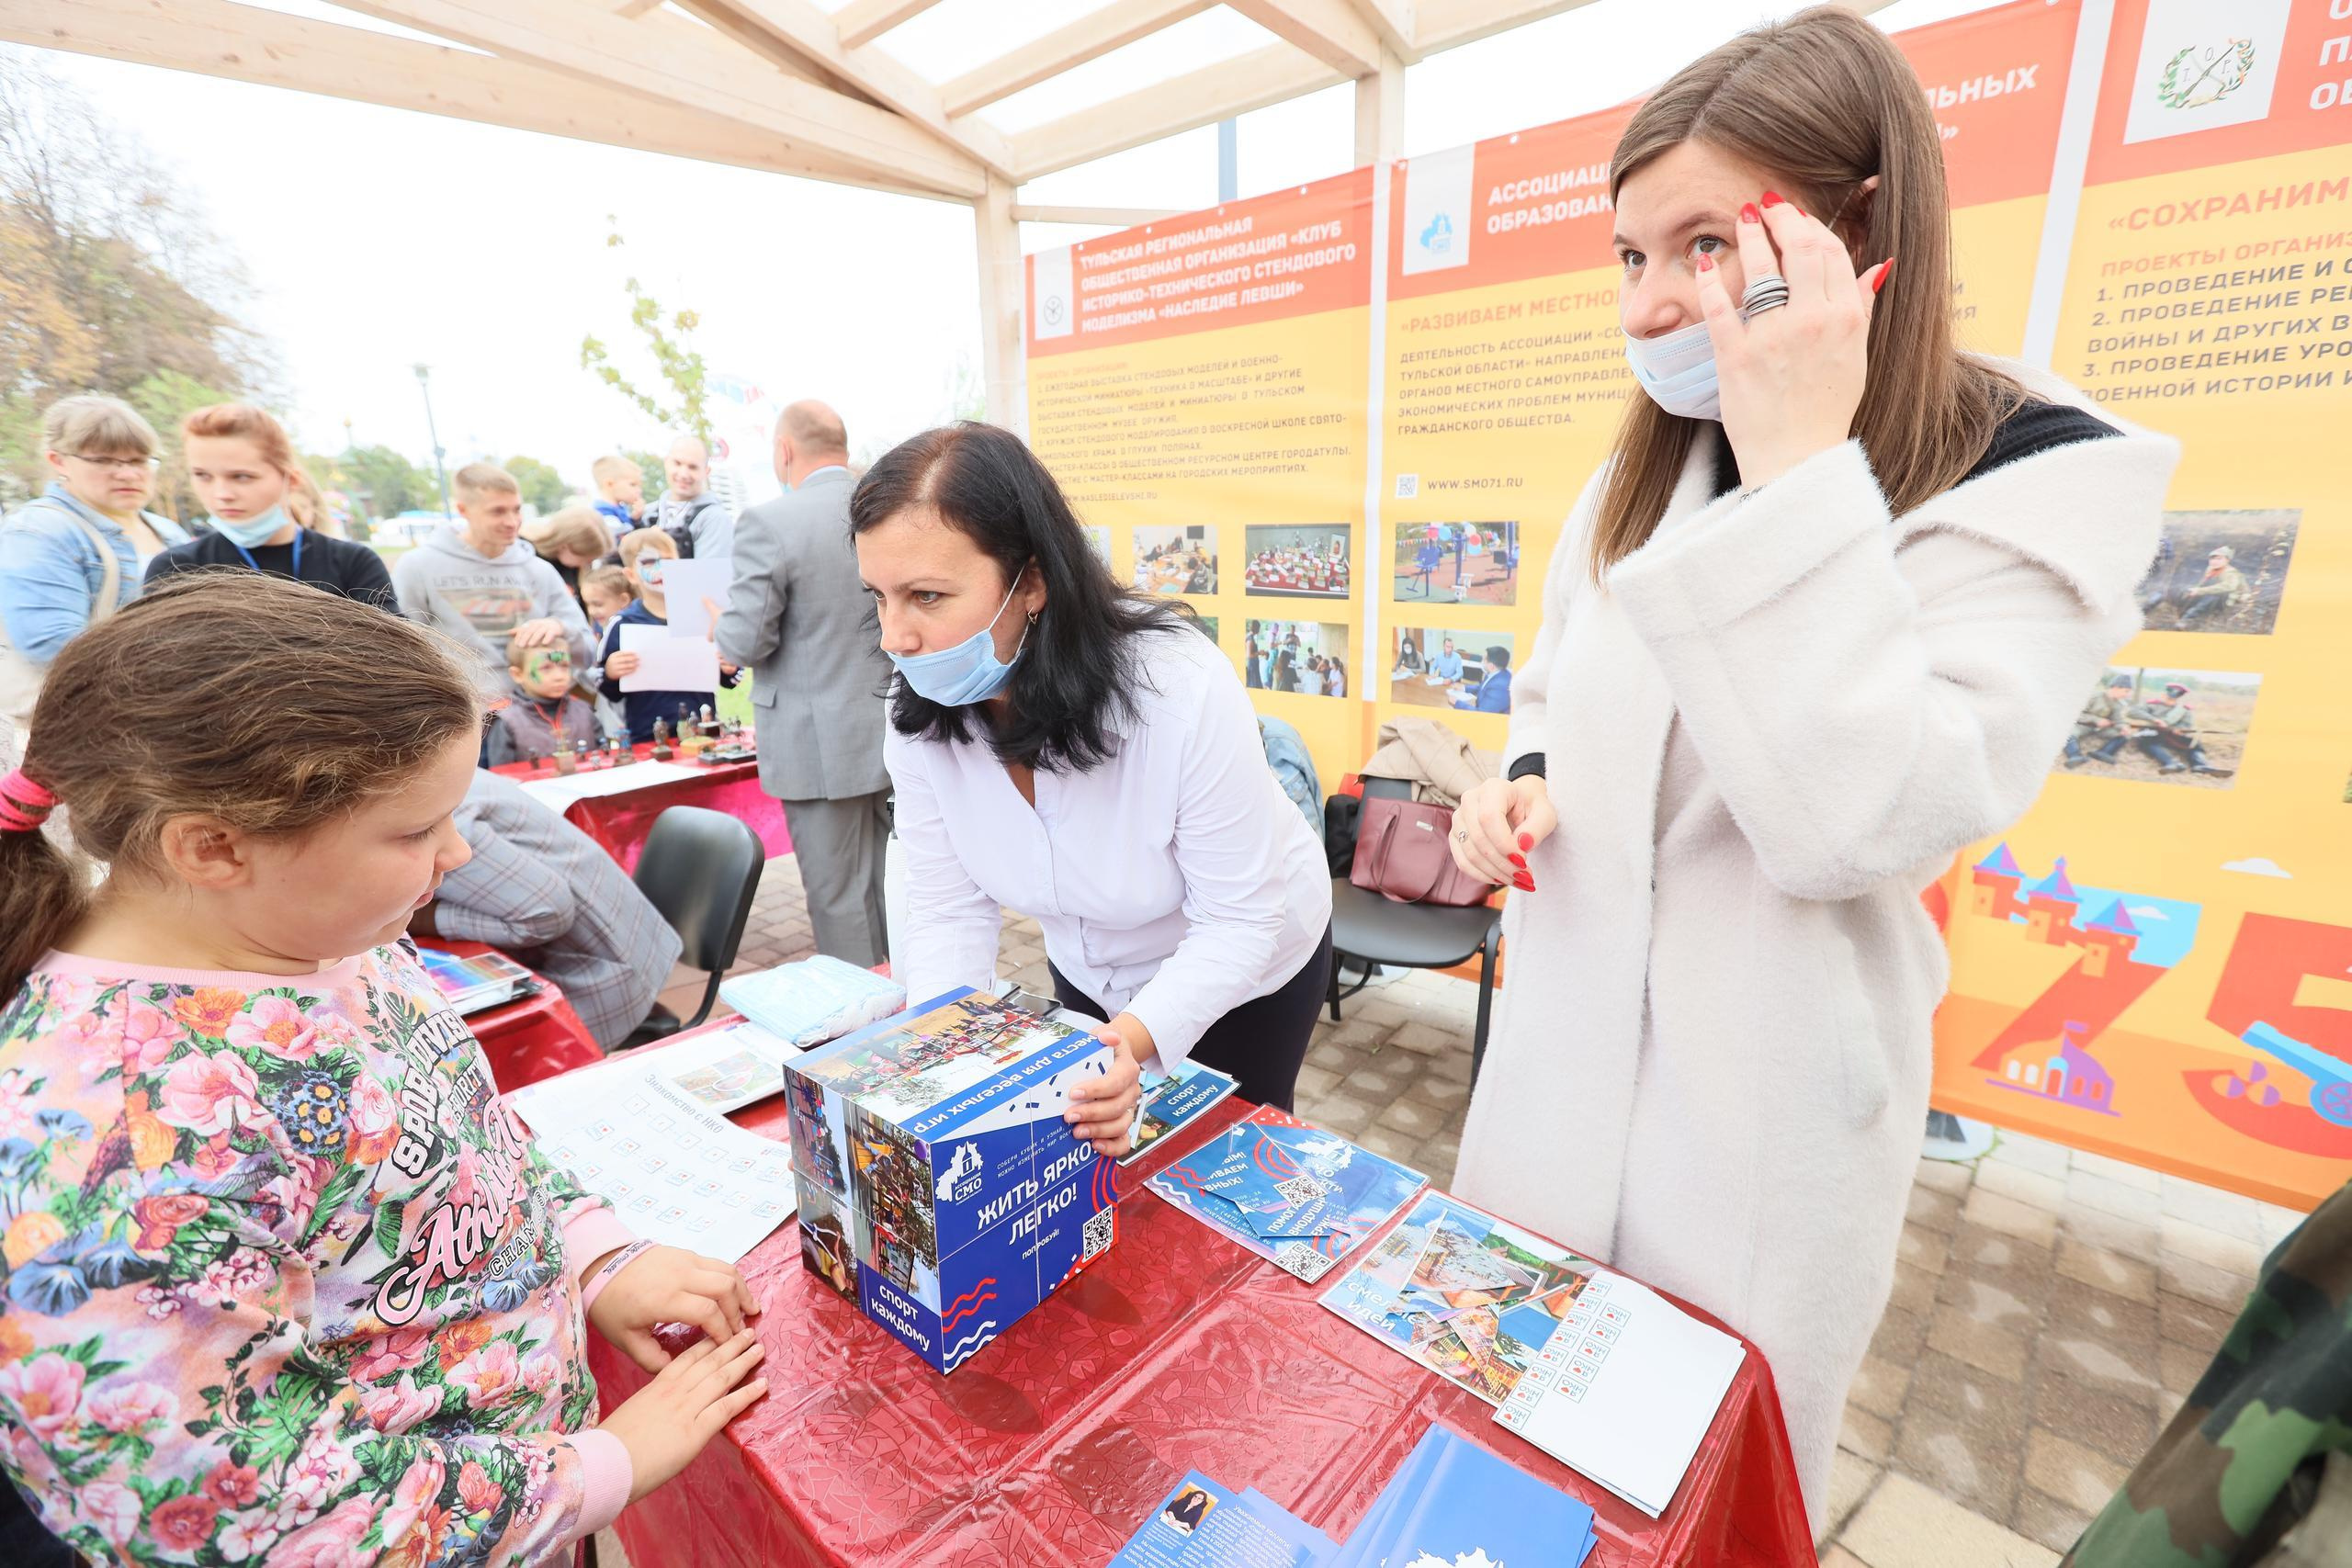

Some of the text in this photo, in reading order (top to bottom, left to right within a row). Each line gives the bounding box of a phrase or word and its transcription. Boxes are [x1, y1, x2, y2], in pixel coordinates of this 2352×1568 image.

[1487, 160, 1611, 207] АССОЦИАЦ
[1486, 194, 1613, 235] ОБРАЗОВАН
[2107, 175, 2351, 231] «СОХРАНИМ
[1080, 216, 1253, 271] ТУЛЬСКАЯ РЕГИОНАЛЬНАЯ
[1081, 220, 1342, 291] ОБЩЕСТВЕННАЯ ОРГАНИЗАЦИЯ «КЛУБ
[2100, 231, 2352, 278] ПРОЕКТЫ ОРГАНИЗ
[1082, 243, 1357, 312] ИСТОРИКО-ТЕХНИЧЕСКОГО СТЕНДОВОГО
[2095, 287, 2114, 303] 1.
[2121, 264, 2305, 300] ПРОВЕДЕНИЕ
[2313, 260, 2335, 277] И
[1082, 279, 1306, 333] МОДЕЛИЗМА «НАСЛЕДИЕ ЛЕВШИ»
[1399, 288, 1622, 334] «РАЗВИВАЕМ МЕСТНО
[2090, 311, 2111, 328] 2.
[2119, 290, 2301, 324] ПРОВЕДЕНИЕ
[2086, 331, 2179, 354] ВОЙНЫ
[2188, 328, 2204, 344] И
[2212, 316, 2323, 344] ДРУГИХ
[1399, 342, 1496, 365] ДЕЯТЕЛЬНОСТЬ
[1499, 330, 1593, 352] АССОЦИАЦИИ
[2081, 340, 2352, 378] 3. ПРОВЕДЕНИЕ УРО
[1187, 358, 1229, 375] МОДЕЛЕЙ
[1240, 354, 1283, 368] ВОЕННО-
[1399, 363, 1462, 382] ТУЛЬСКОЙ
[1465, 358, 1532, 375] ОБЛАСТИ»
[1198, 375, 1253, 389] МАСШТАБЕ»
[1255, 374, 1262, 383] И
[1264, 367, 1303, 383] ДРУГИЕ
[1398, 367, 1634, 400] ОРГАНОВ МЕСТНОГО САМОУПРАВЛЕ
[2205, 370, 2334, 396] ИСТОРИИ
[1254, 385, 1306, 400] ТУЛЬСКОМ
[1397, 398, 1504, 419] ЭКОНОМИЧЕСКИХ
[1507, 392, 1571, 410] ПРОБЛЕМ
[1210, 418, 1270, 434] ВОСКРЕСНОЙ
[1272, 416, 1306, 429] ШКОЛЕ
[1309, 413, 1348, 425] СВЯТО-
[1396, 412, 1577, 436] ГРАЖДАНСКОГО ОБЩЕСТВА.
[1188, 451, 1240, 464] РЕСУРСНОМ
[1242, 449, 1279, 462] ЦЕНТРЕ
[1179, 468, 1229, 479] ГОРОДСКИХ
[1231, 463, 1309, 477] МЕРОПРИЯТИЯХ.
[1427, 477, 1524, 491] WWW.SMO71.RU
[1069, 491, 1159, 502] W.NASLEDIELEVSHI.RU
[1021, 1056, 1053, 1076] для
[644, 1073, 695, 1117] Знакомство
[701, 1115, 725, 1134] НКО
[946, 1074, 1023, 1116] веселых
[1167, 1084, 1198, 1106] спорт
[1172, 1084, 1220, 1117] каждому
[913, 1111, 949, 1134] игр
[1222, 1151, 1247, 1165] ЫМ!
[1207, 1163, 1250, 1180] ИВАЕМ
[955, 1178, 982, 1201] СМО
[1200, 1177, 1244, 1192] ВНЫХ!
[977, 1179, 1040, 1231] ЖИТЬ
[1009, 1181, 1078, 1246] ЛЕГКО!
[1286, 1195, 1327, 1235] ВНОДУШН
[879, 1285, 919, 1321] спорт
[1608, 1306, 1626, 1319] НКО
[871, 1298, 931, 1352] каждому
[1556, 1330, 1575, 1339] НКО
[1597, 1324, 1616, 1335] НКО
[1544, 1348, 1564, 1357] НКО
[1586, 1342, 1606, 1354] НКО
[1532, 1366, 1552, 1376] НКО
[1574, 1360, 1595, 1373] НКО
[1519, 1385, 1539, 1396] НКО
[1562, 1380, 1584, 1393] НКО
[1505, 1404, 1527, 1417] НКО
